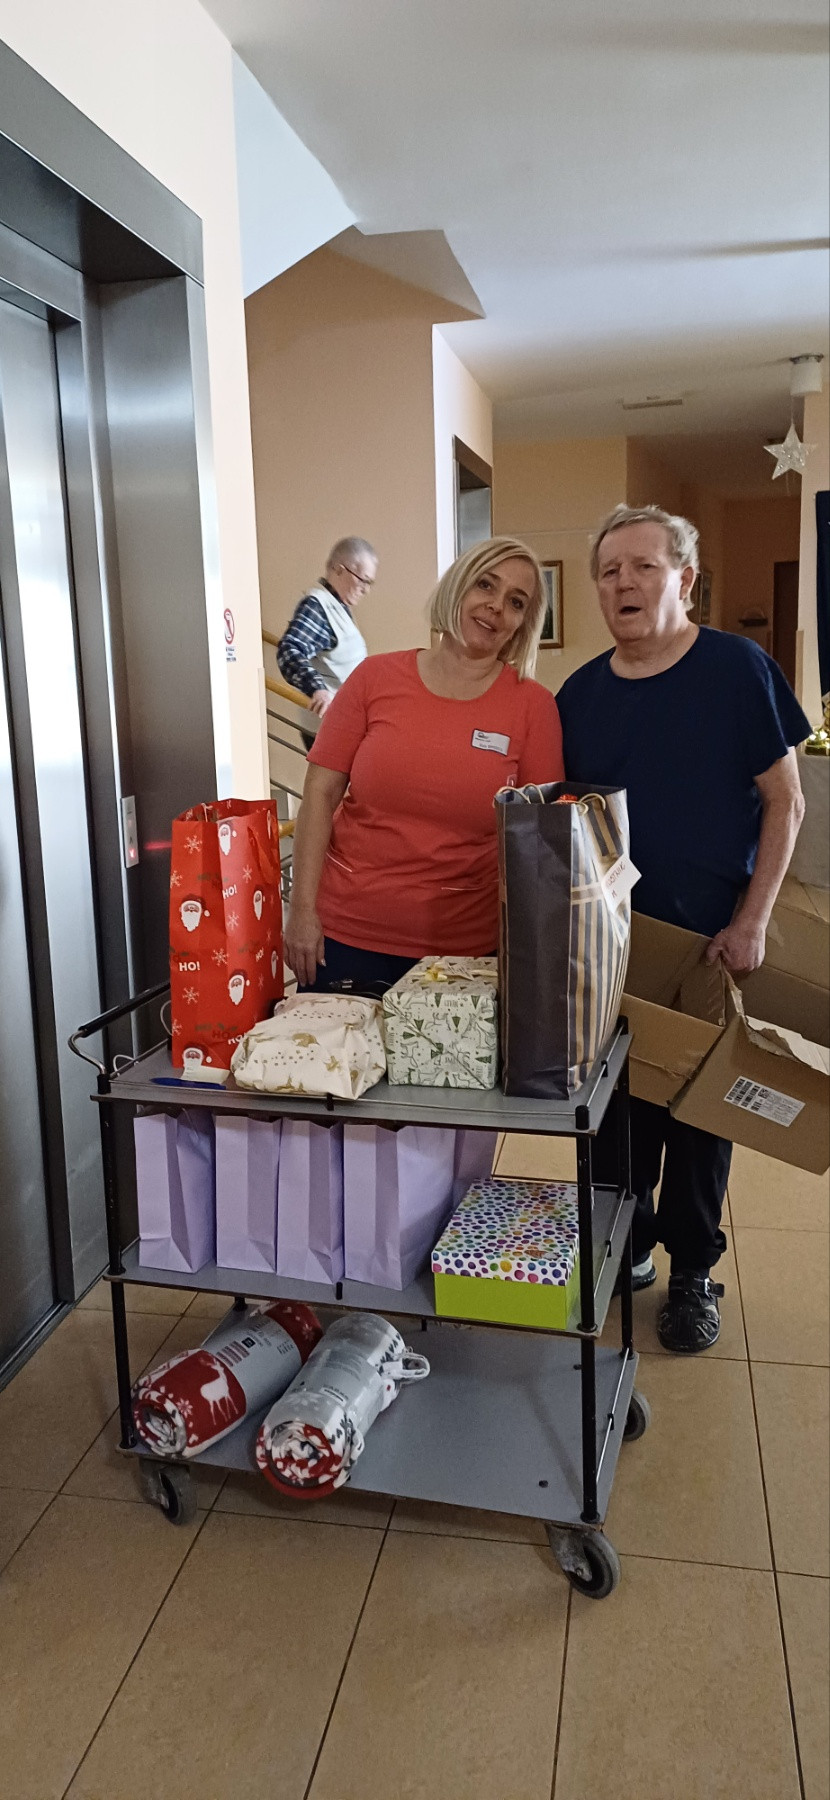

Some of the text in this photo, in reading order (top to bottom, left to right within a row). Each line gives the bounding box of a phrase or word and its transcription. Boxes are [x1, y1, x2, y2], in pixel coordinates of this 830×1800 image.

[222, 884, 238, 900] HO!
[255, 946, 264, 962] HO!
[178, 961, 200, 972] HO!
